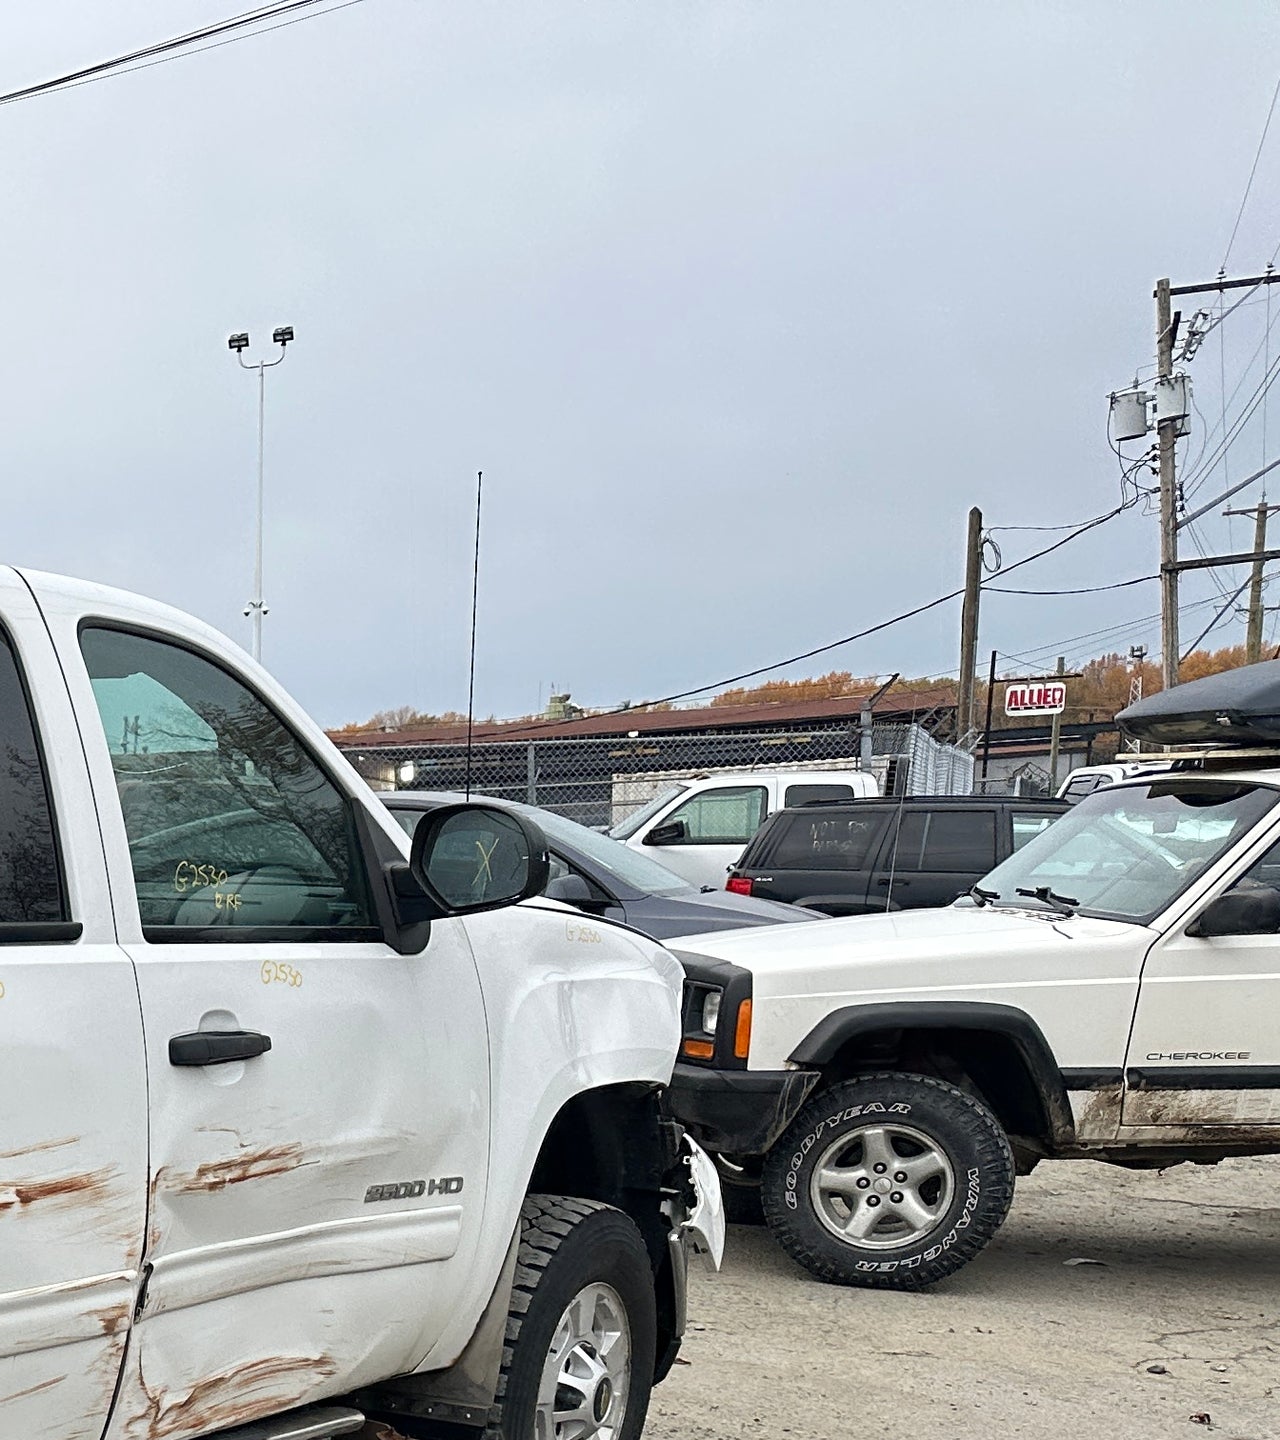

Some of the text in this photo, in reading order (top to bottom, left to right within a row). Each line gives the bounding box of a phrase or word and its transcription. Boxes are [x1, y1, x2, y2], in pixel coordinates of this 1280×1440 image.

[174, 860, 228, 892] G2530
[260, 960, 303, 988] G2530
[1145, 1051, 1252, 1061] CHEROKEE
[784, 1102, 912, 1210] GOODYEAR
[428, 1176, 464, 1196] HD
[855, 1168, 980, 1272] WRANGLER
